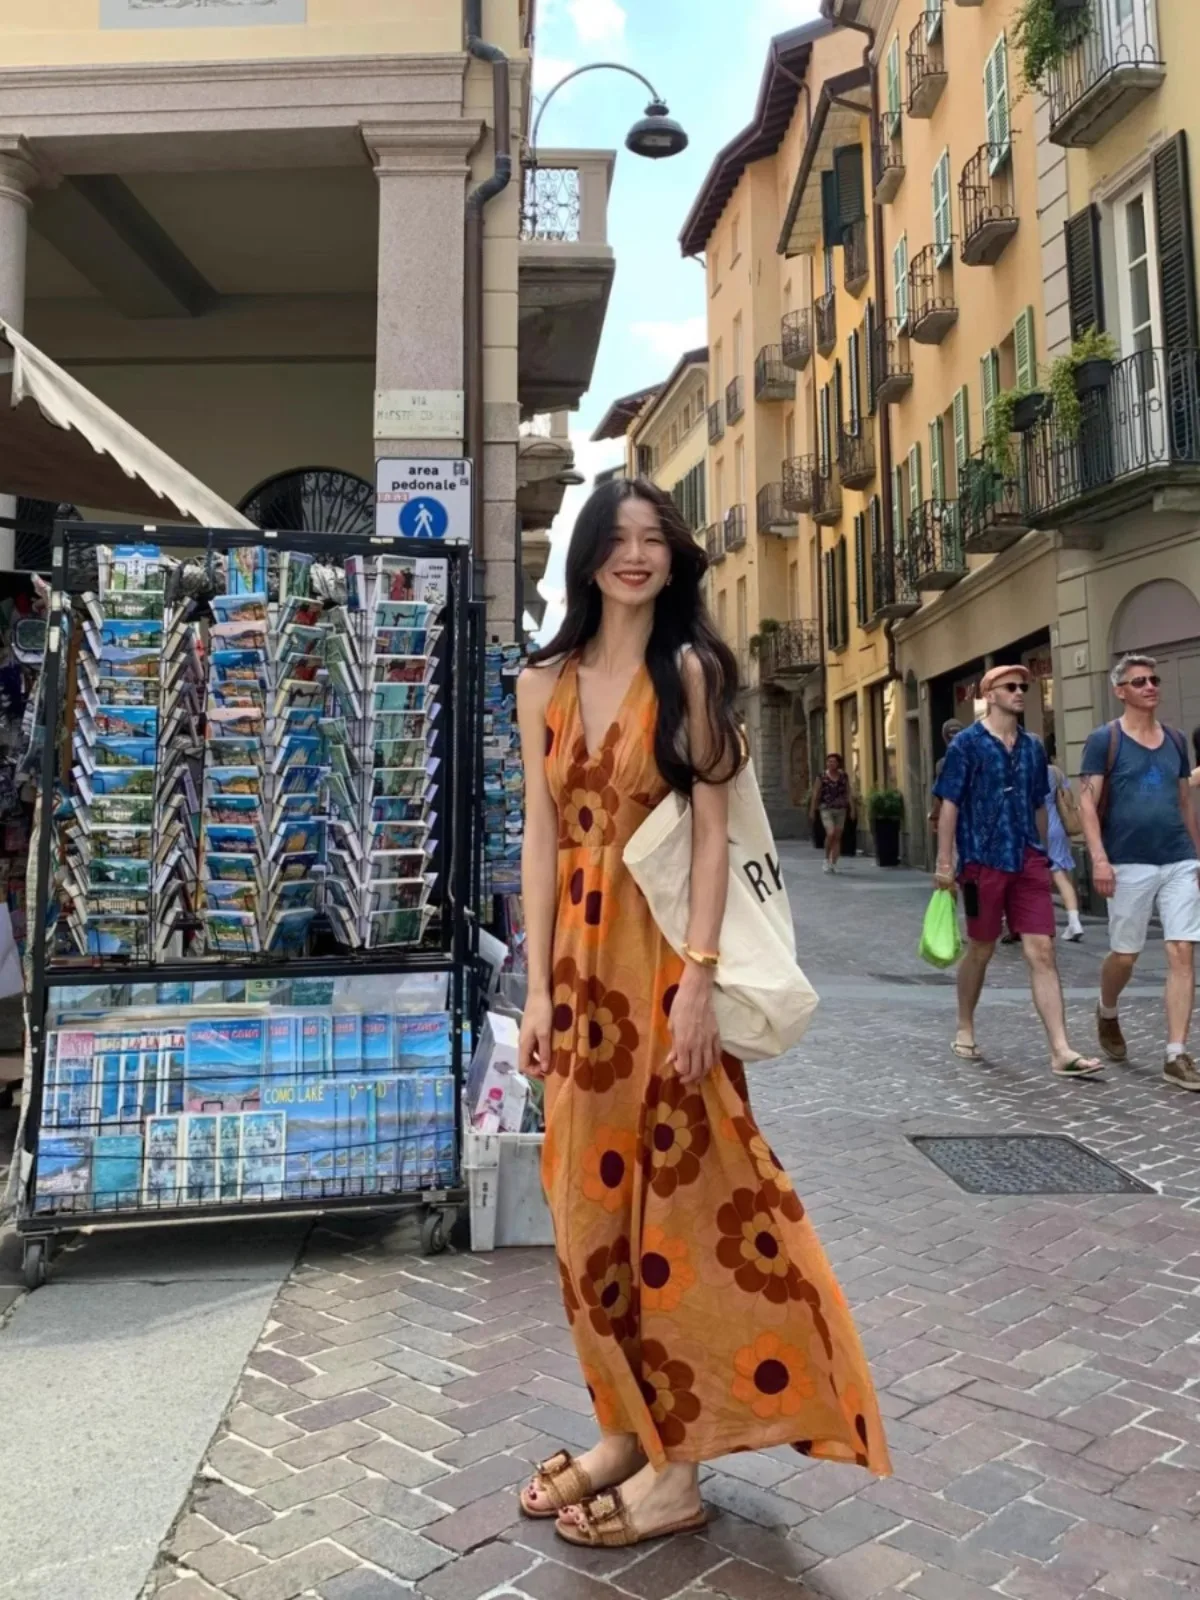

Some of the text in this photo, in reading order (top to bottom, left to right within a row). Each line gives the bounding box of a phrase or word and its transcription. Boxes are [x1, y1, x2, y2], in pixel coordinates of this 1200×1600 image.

[408, 466, 439, 476] area
[391, 479, 457, 491] pedonale
[264, 1085, 325, 1104] COMO LAKE
